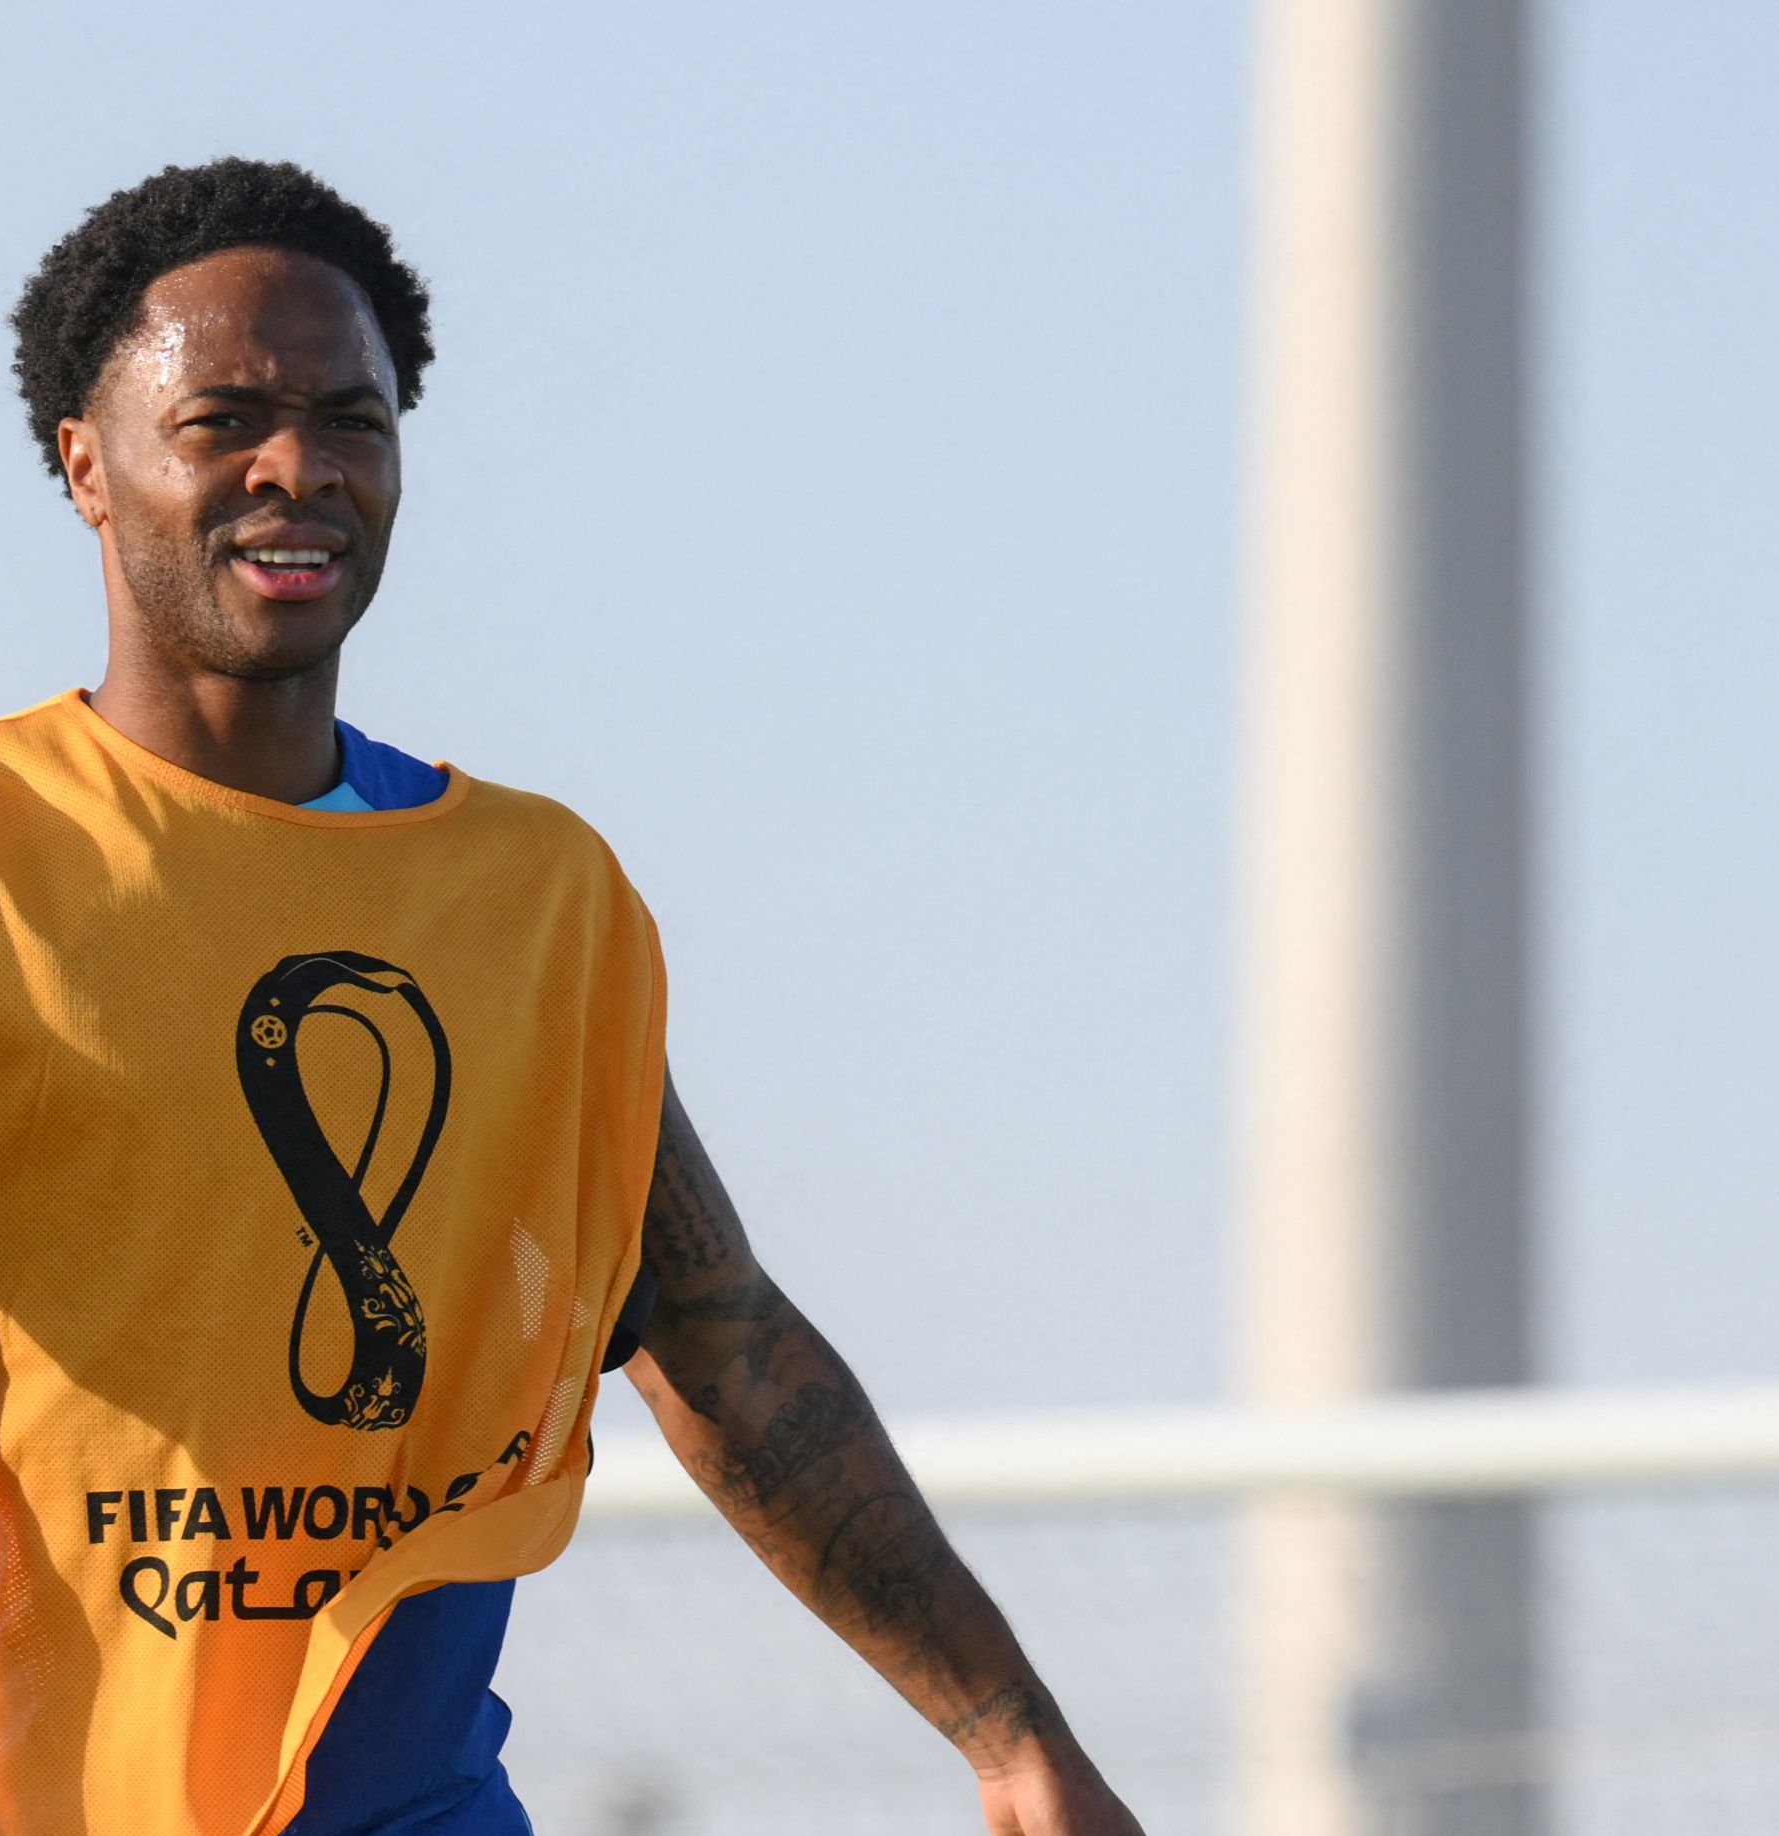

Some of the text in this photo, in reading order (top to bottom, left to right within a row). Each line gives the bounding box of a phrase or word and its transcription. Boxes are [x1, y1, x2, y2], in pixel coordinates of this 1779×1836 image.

[296, 1227, 314, 1247] TM
[86, 1488, 231, 1544] FIFA
[121, 1556, 361, 1640] Qata
